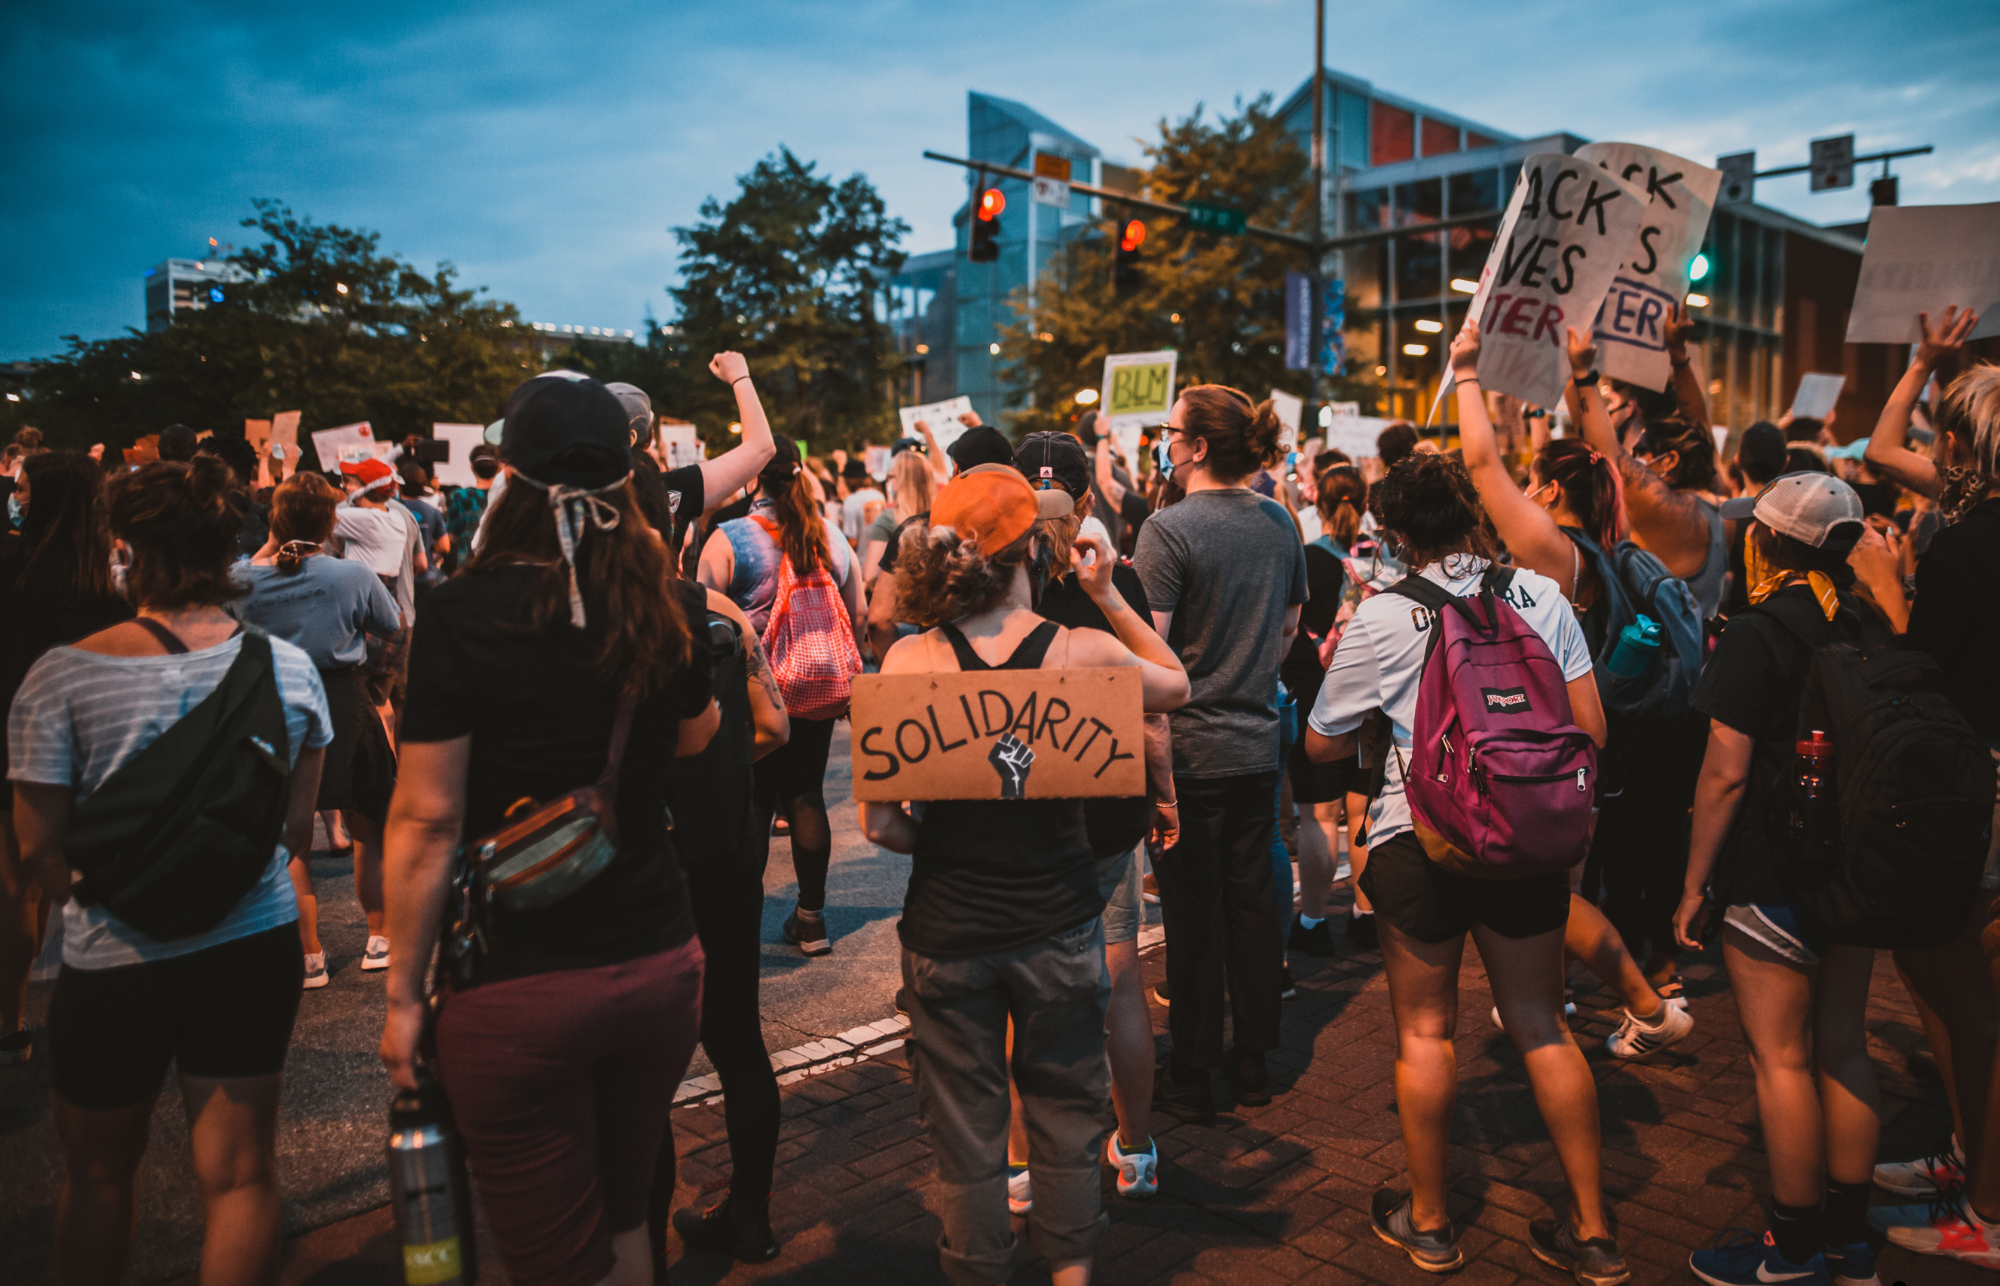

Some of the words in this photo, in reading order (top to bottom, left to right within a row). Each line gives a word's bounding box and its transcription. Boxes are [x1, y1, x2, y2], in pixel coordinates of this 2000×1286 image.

[1499, 235, 1586, 295] VES
[1486, 293, 1564, 347] TER
[1112, 367, 1168, 403] BLM
[860, 690, 1134, 781] SOLIDARITY
